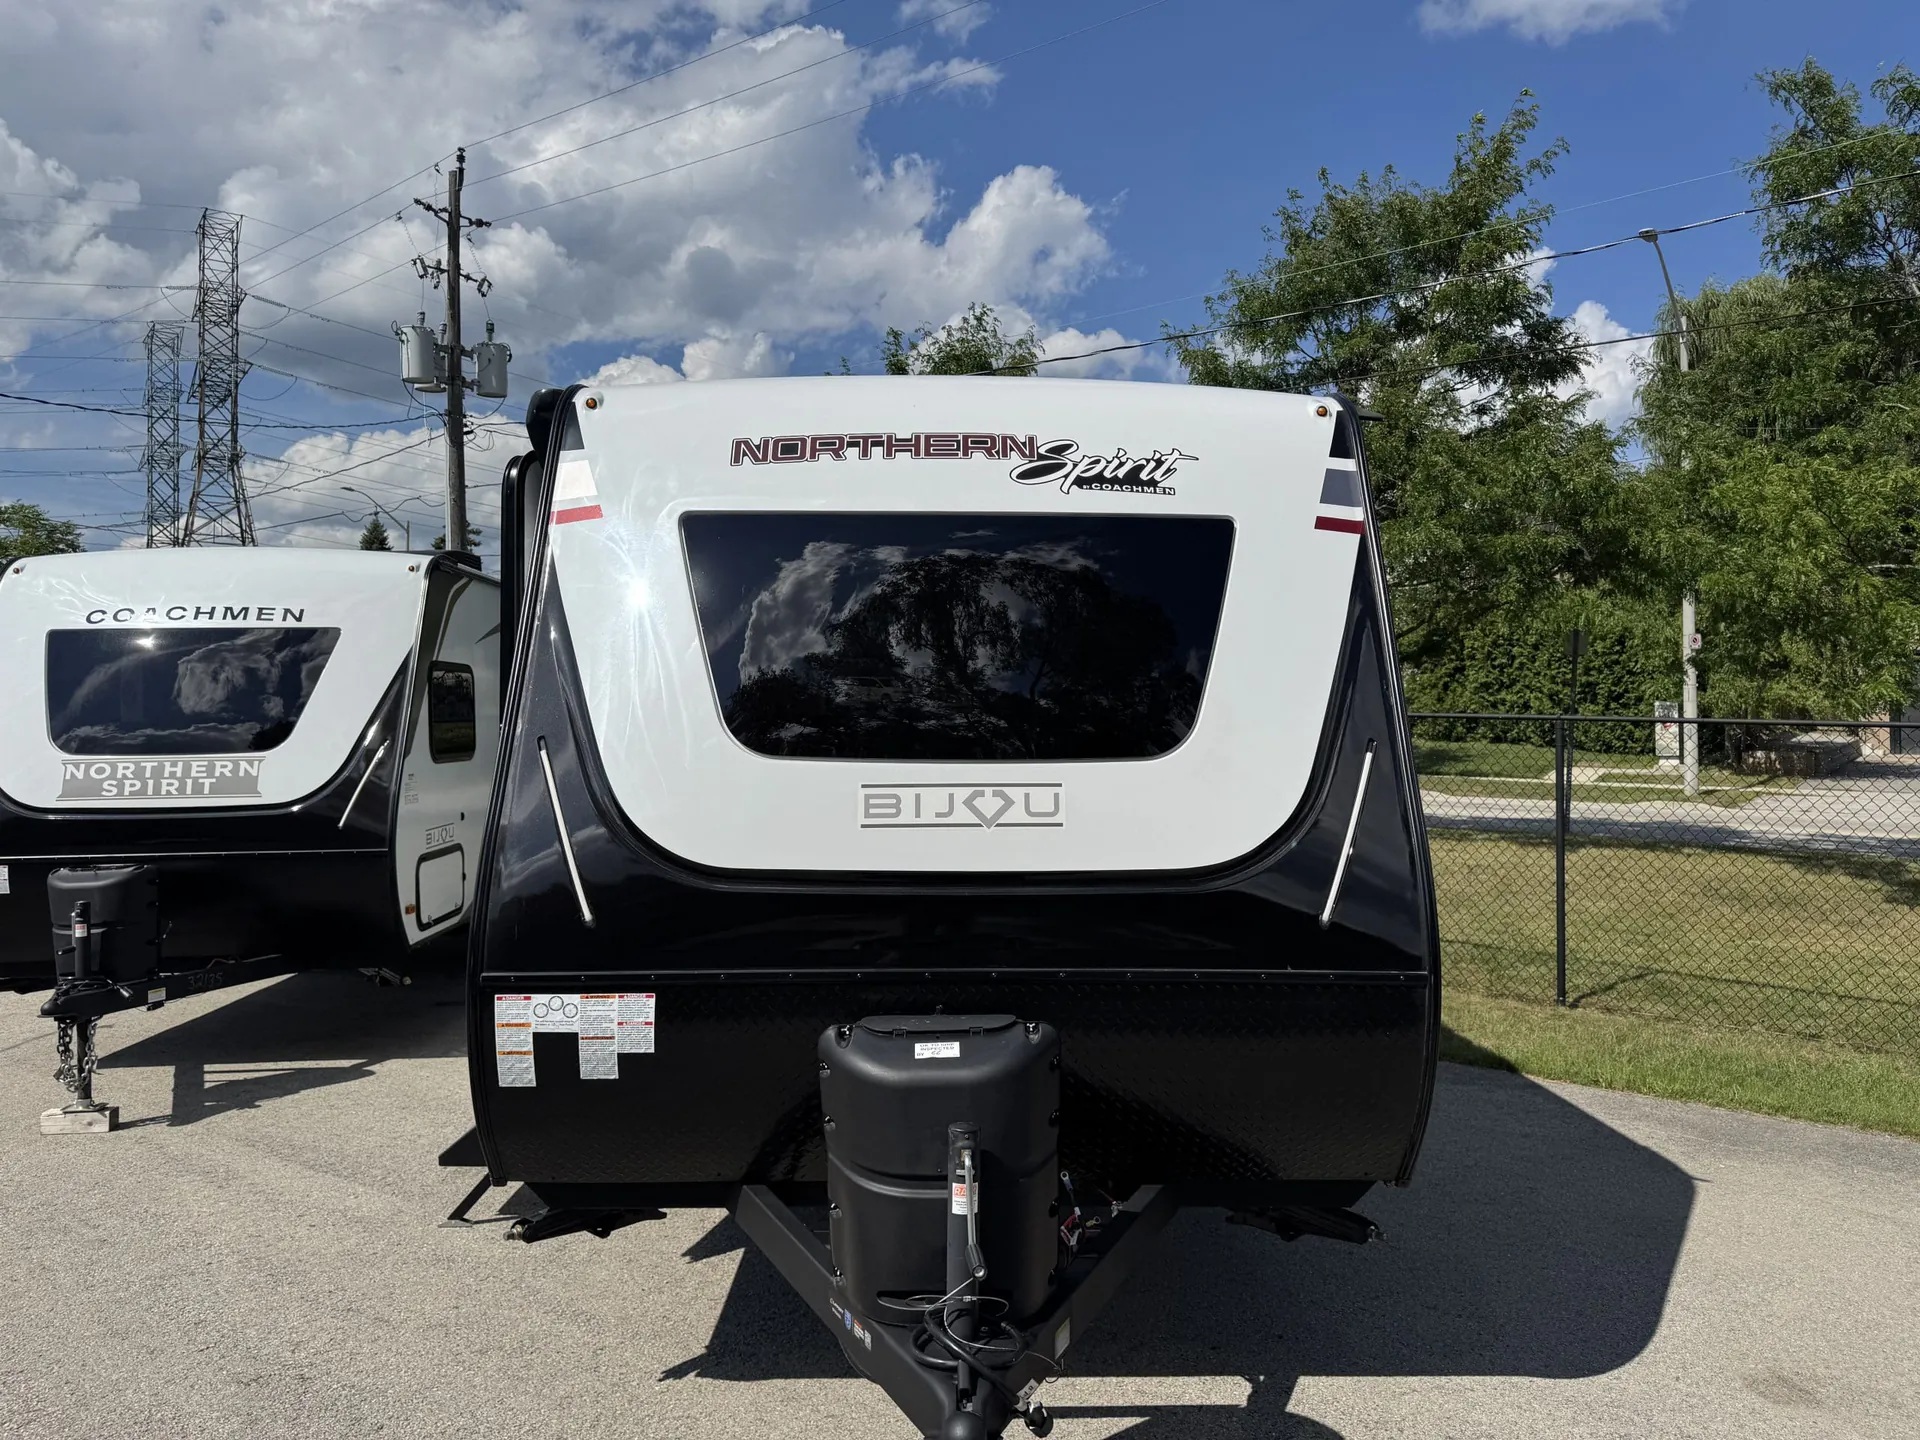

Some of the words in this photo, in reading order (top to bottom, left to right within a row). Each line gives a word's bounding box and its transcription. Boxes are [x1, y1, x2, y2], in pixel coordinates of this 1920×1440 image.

[730, 433, 1037, 466] NORTHERN
[1010, 439, 1199, 494] Spirit
[1091, 483, 1175, 495] COACHMEN
[85, 606, 305, 624] COACHMEN
[65, 760, 260, 780] NORTHERN
[101, 778, 216, 796] SPIRIT
[864, 789, 1060, 830] BIJOU
